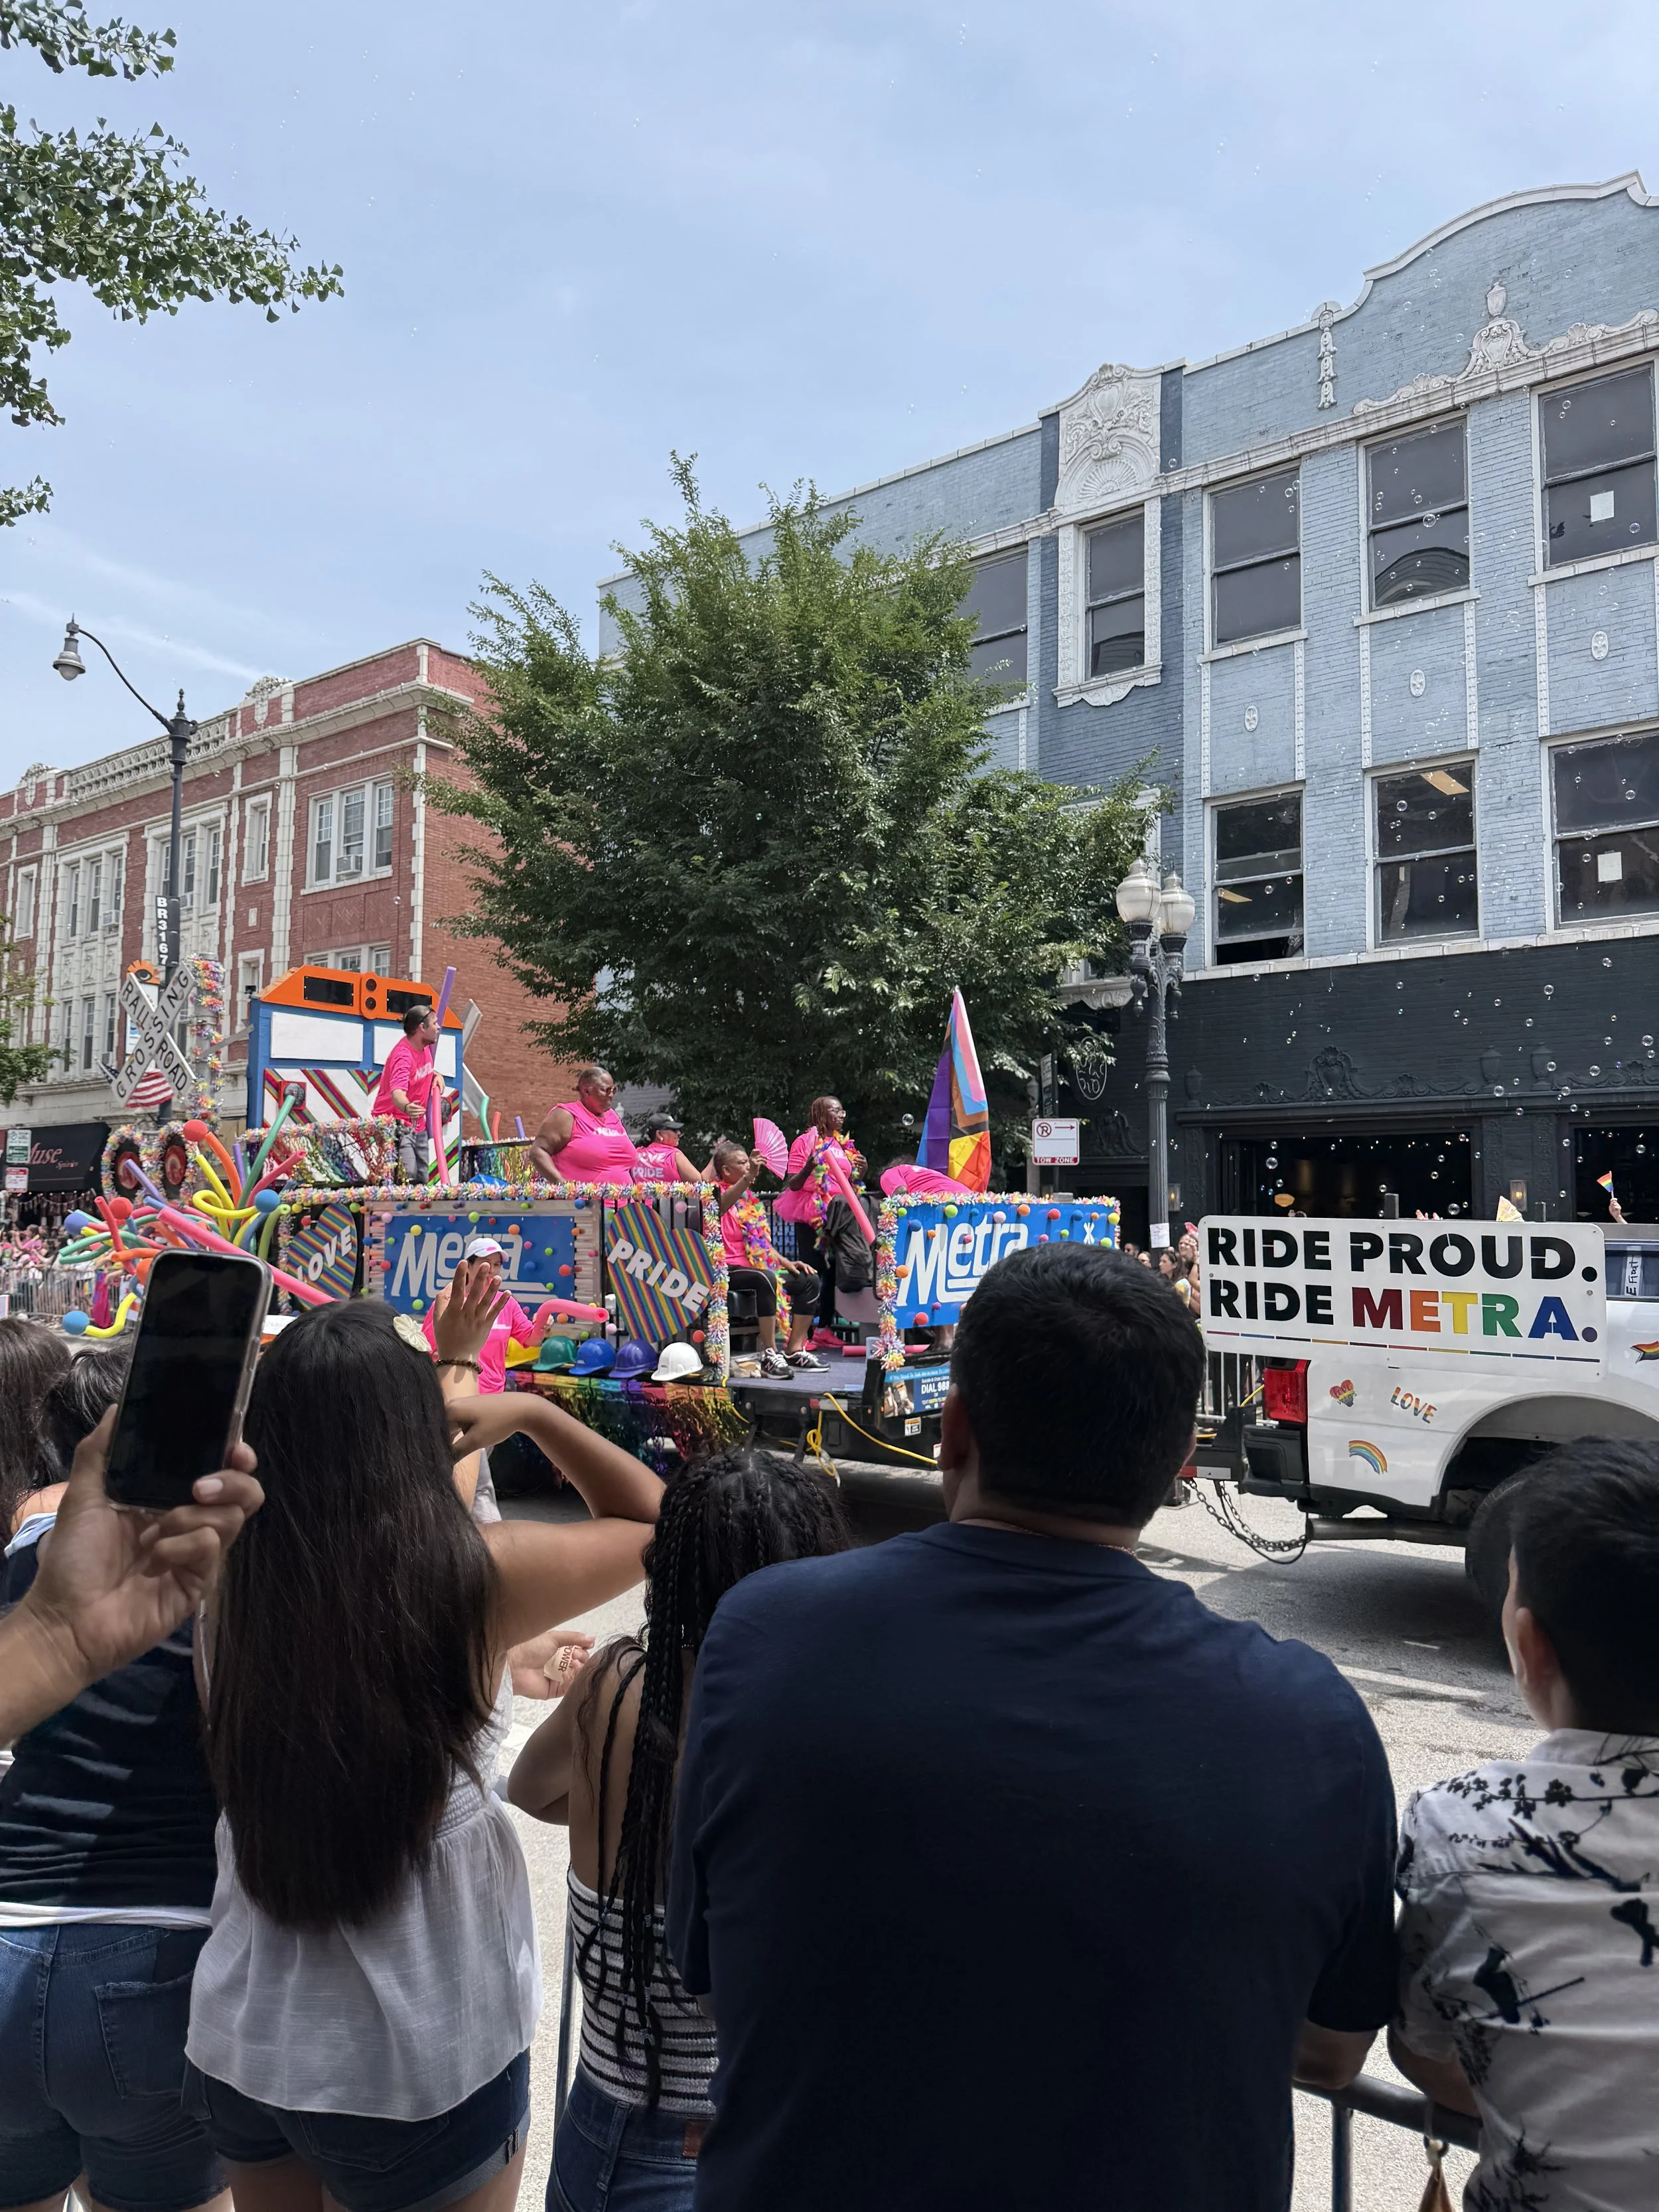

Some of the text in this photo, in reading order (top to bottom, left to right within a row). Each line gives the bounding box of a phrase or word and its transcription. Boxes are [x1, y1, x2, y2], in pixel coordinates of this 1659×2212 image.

[157, 897, 169, 966] BR3167
[116, 970, 189, 1098] CROSSING
[123, 981, 188, 1092] RAIL ROAD
[632, 1167, 664, 1178] PRIDE
[390, 1225, 523, 1298] Mea
[607, 1238, 710, 1313] PRIDE
[1207, 1228, 1332, 1271] RIDE
[1350, 1232, 1598, 1282] PROUD.
[1210, 1279, 1598, 1343] RIDE METRA.
[921, 1382, 937, 1394] DIAL
[1390, 1386, 1438, 1424] LOVE
[557, 1646, 573, 1672] OWER
